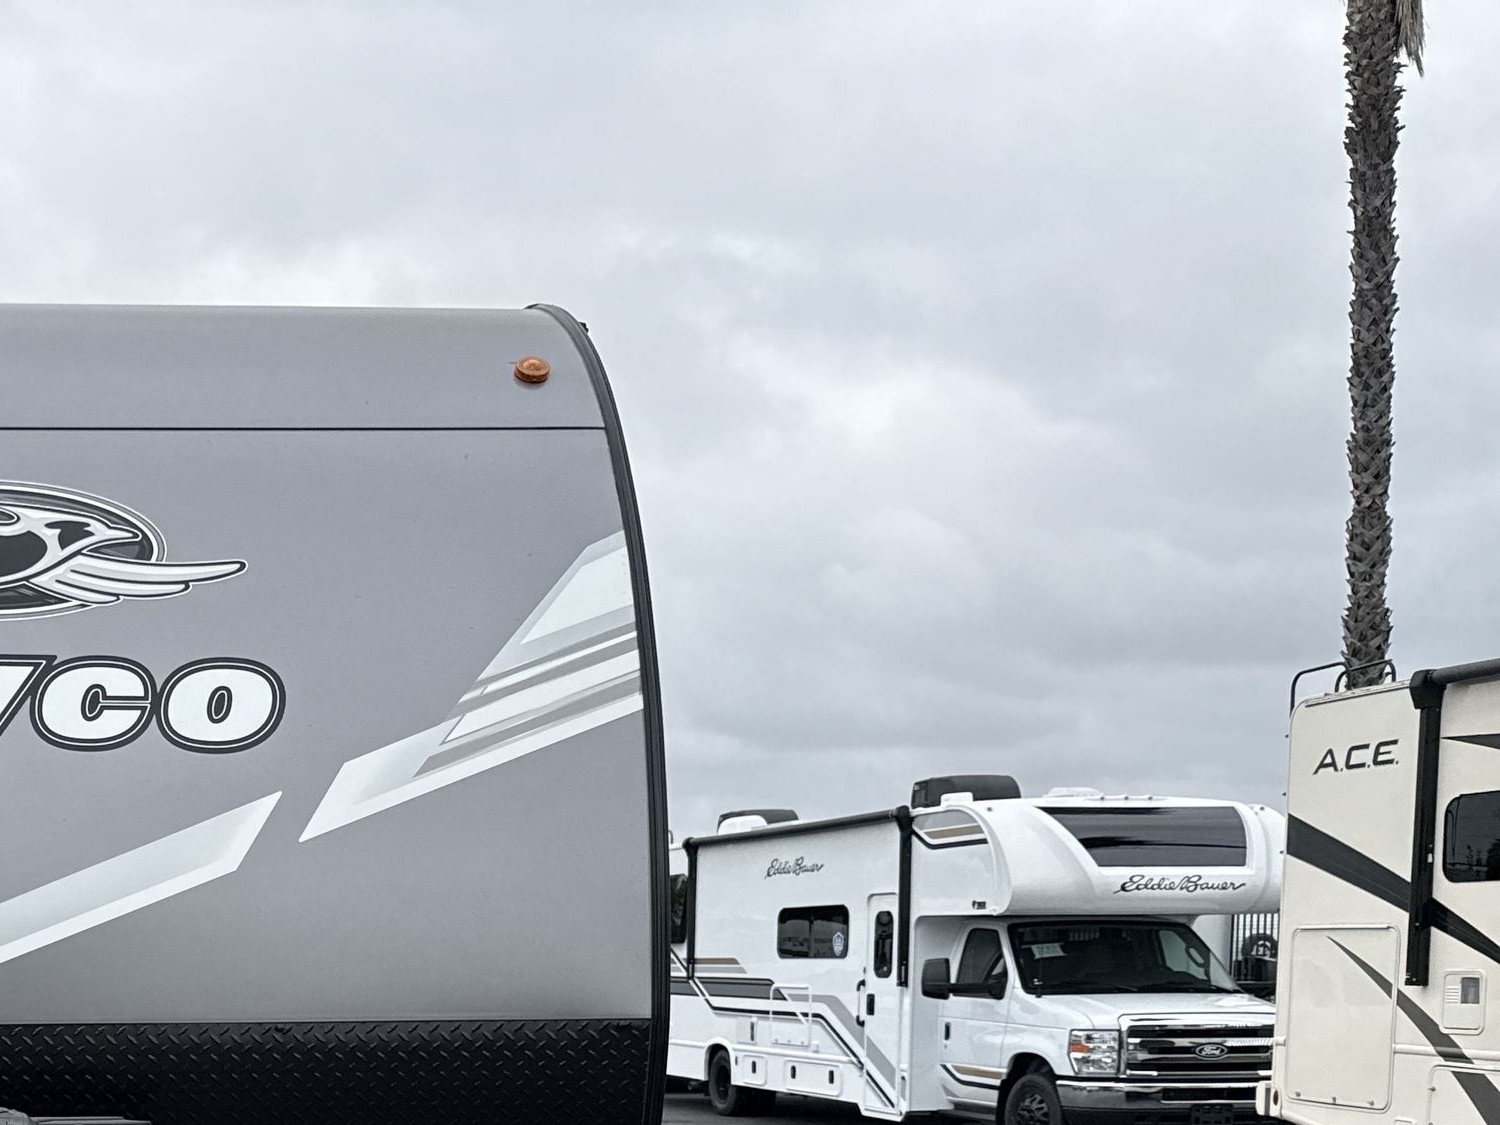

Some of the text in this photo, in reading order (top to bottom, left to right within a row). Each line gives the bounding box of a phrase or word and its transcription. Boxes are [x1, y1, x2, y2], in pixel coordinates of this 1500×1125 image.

[764, 856, 824, 880] Eddie Bauer
[1113, 874, 1246, 894] Eddie Bauer
